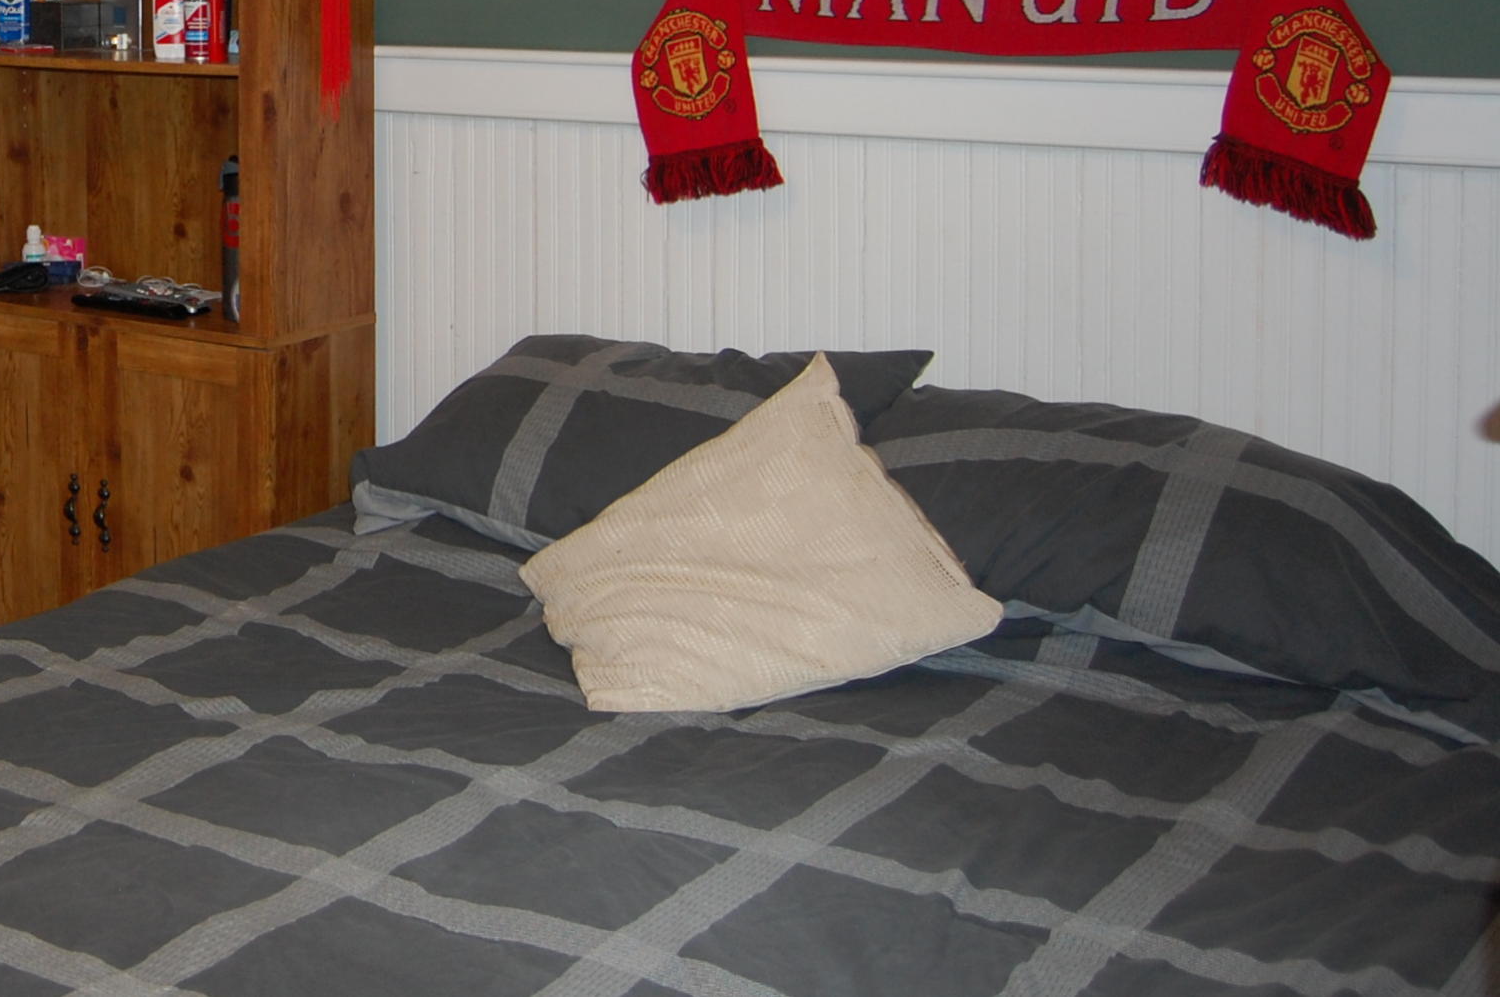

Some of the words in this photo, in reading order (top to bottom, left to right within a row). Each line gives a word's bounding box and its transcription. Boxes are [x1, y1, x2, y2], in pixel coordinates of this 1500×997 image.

[645, 15, 719, 60] MANCHESTER
[1274, 14, 1365, 67] MANCHESTER
[674, 92, 716, 112] UNITED
[1274, 98, 1328, 126] UNITED
